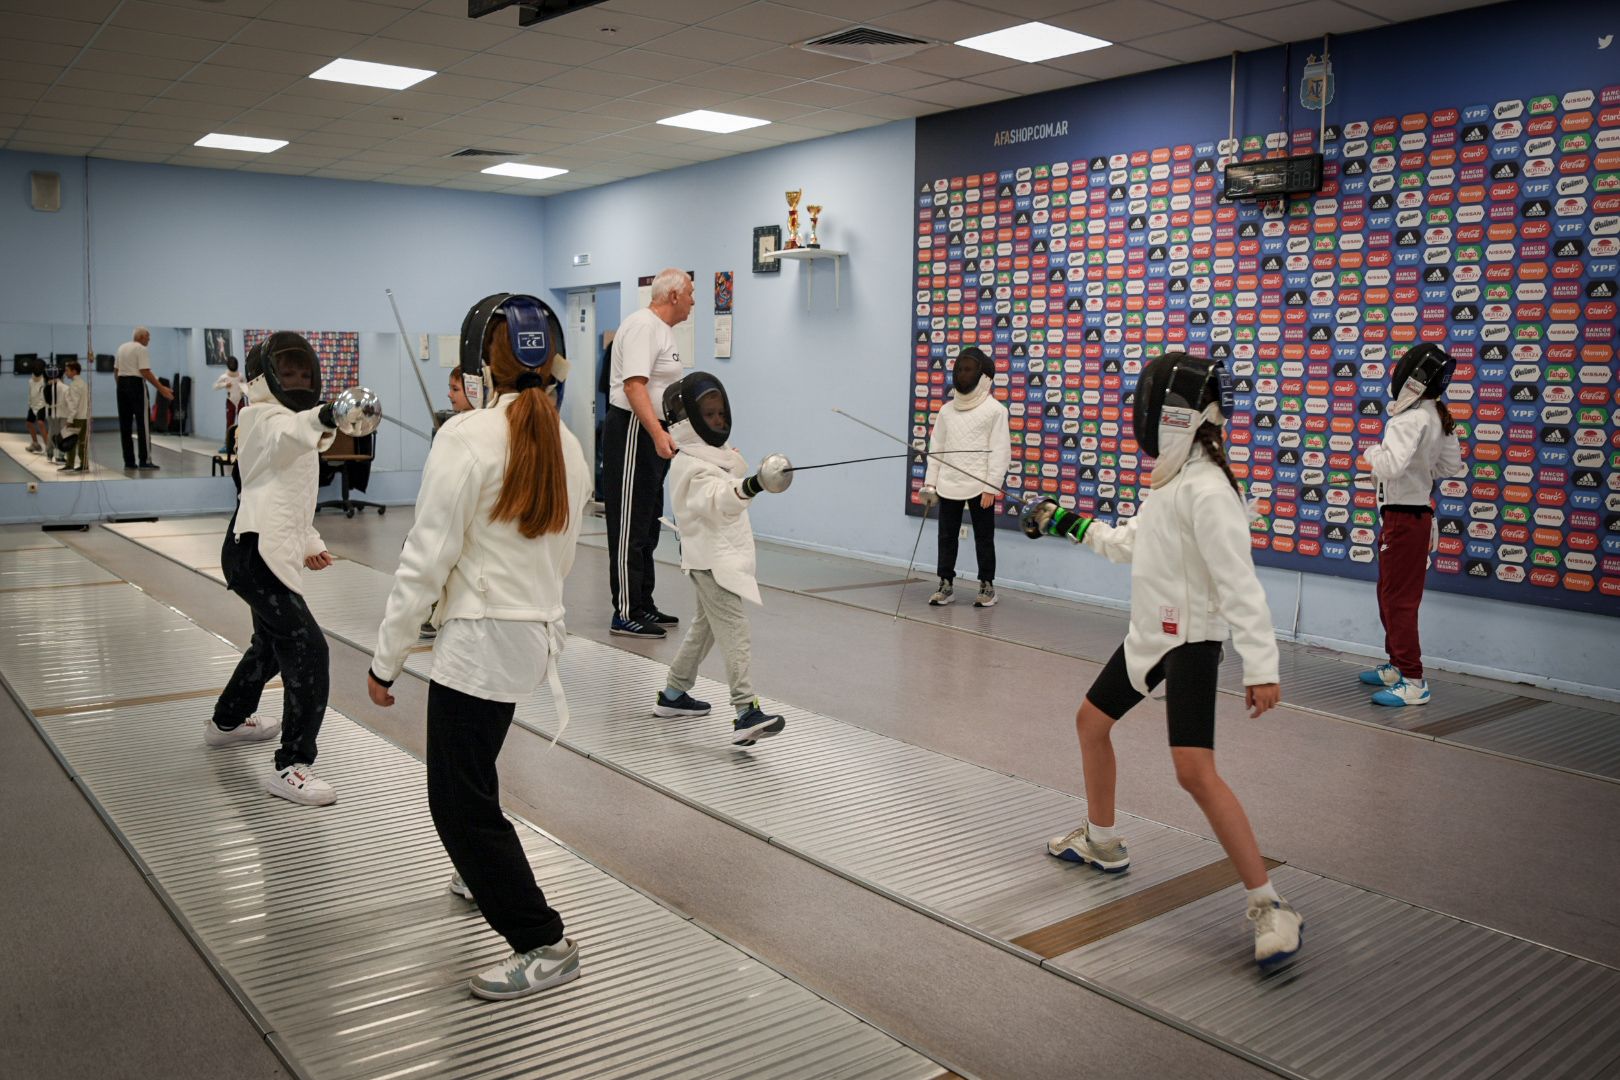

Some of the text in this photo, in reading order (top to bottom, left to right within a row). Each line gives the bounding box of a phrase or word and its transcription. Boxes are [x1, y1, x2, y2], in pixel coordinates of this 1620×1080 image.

[1565, 96, 1591, 104] NISSAN
[1465, 109, 1487, 119] YPF
[994, 120, 1068, 147] AFASHOP.COM.AR
[1463, 150, 1481, 158] Claro
[1495, 146, 1518, 155] YPF
[1345, 182, 1363, 190] YPF
[1526, 184, 1549, 193] YPF
[1493, 188, 1511, 196] Claro
[1371, 217, 1390, 225] YPF
[1524, 226, 1543, 234] Claro
[1558, 223, 1582, 232] YPF
[1398, 253, 1418, 261] YPF
[1591, 264, 1616, 272] YPF
[1509, 450, 1528, 458] Claro
[1542, 452, 1566, 460] YPF
[1539, 493, 1559, 501] Claro
[1574, 496, 1598, 504] YPF
[1302, 508, 1320, 516] YPF
[1442, 504, 1463, 512] YPF
[1570, 536, 1590, 545] Claro
[1439, 542, 1456, 550] Claro
[1470, 545, 1491, 554] YPF
[1326, 547, 1344, 555] YPF
